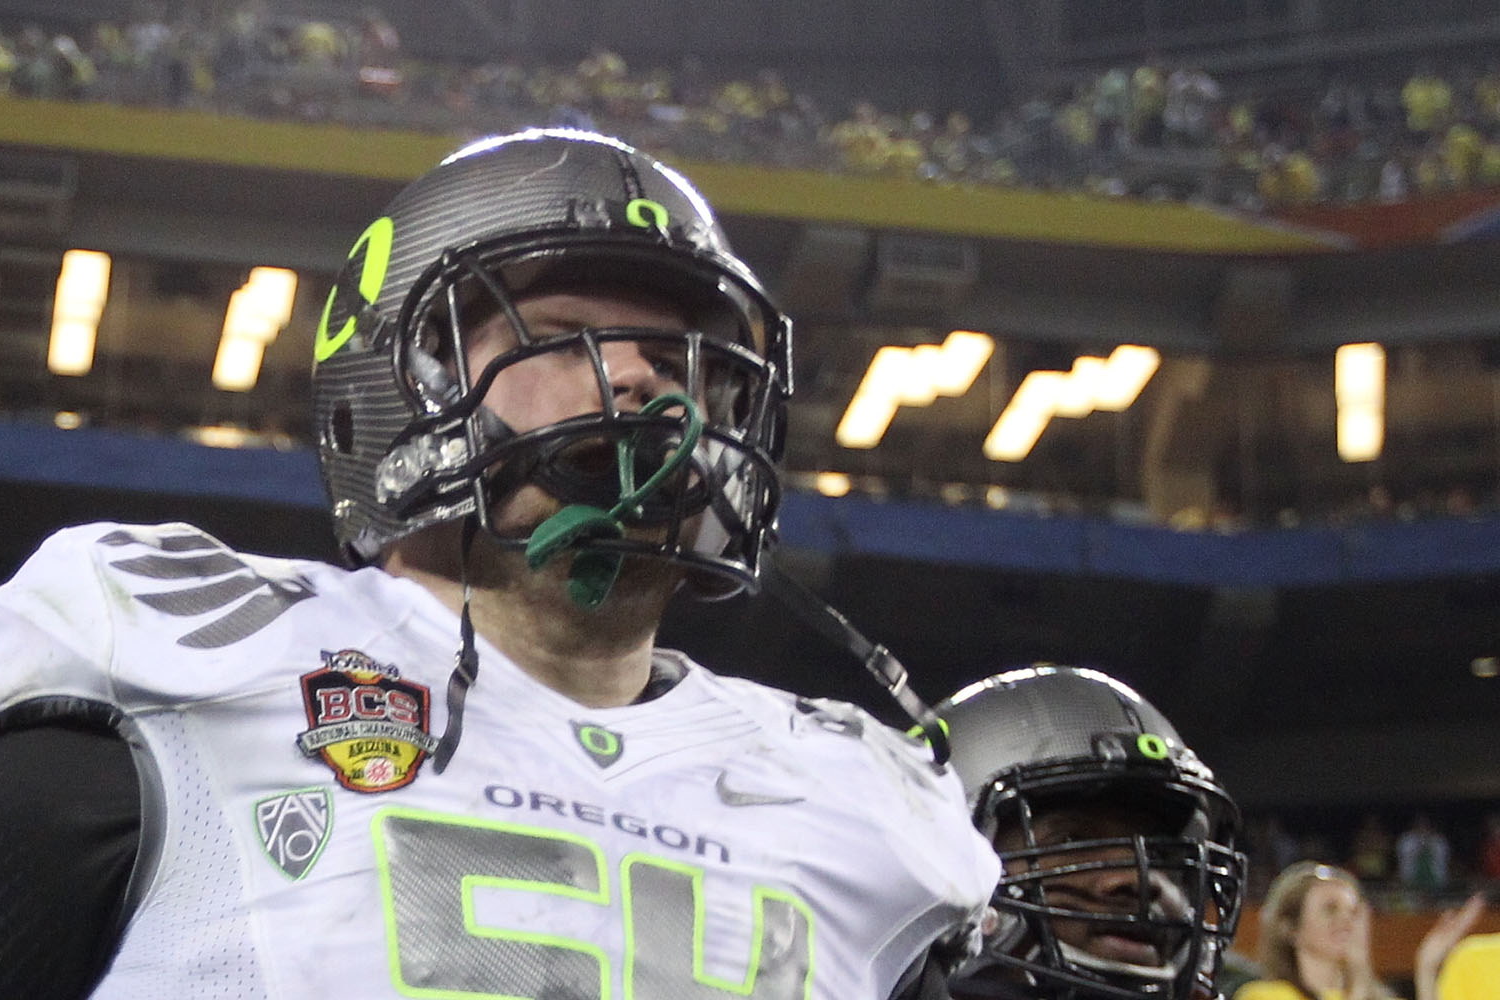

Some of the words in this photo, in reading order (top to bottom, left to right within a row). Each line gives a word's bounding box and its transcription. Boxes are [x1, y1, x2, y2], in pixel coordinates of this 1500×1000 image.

[316, 686, 420, 726] BCS
[348, 739, 401, 758] ARIZONA
[257, 791, 329, 850] PAC
[483, 784, 731, 864] OREGON
